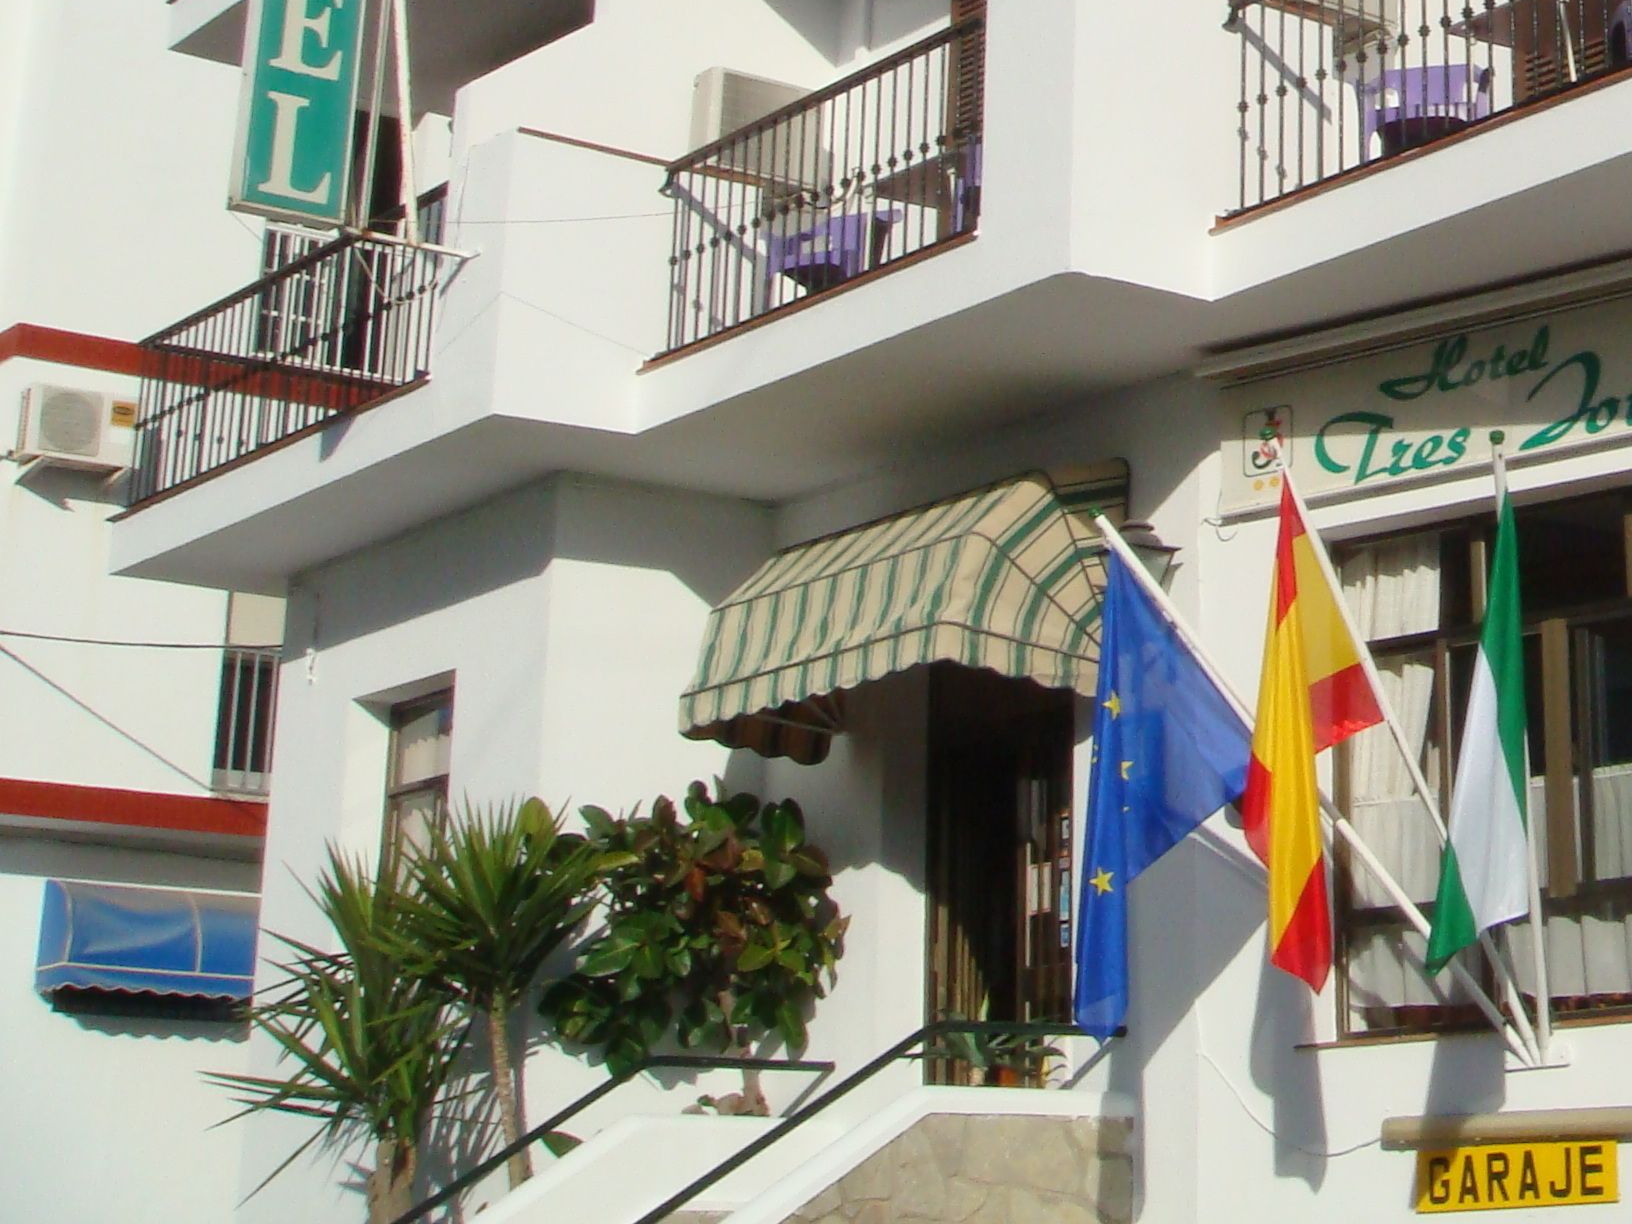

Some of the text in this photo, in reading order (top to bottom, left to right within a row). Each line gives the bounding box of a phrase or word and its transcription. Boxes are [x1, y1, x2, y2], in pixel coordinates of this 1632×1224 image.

[1378, 326, 1550, 401] Hotel
[1314, 411, 1471, 485] Tres
[1428, 1145, 1604, 1205] GARAJE
